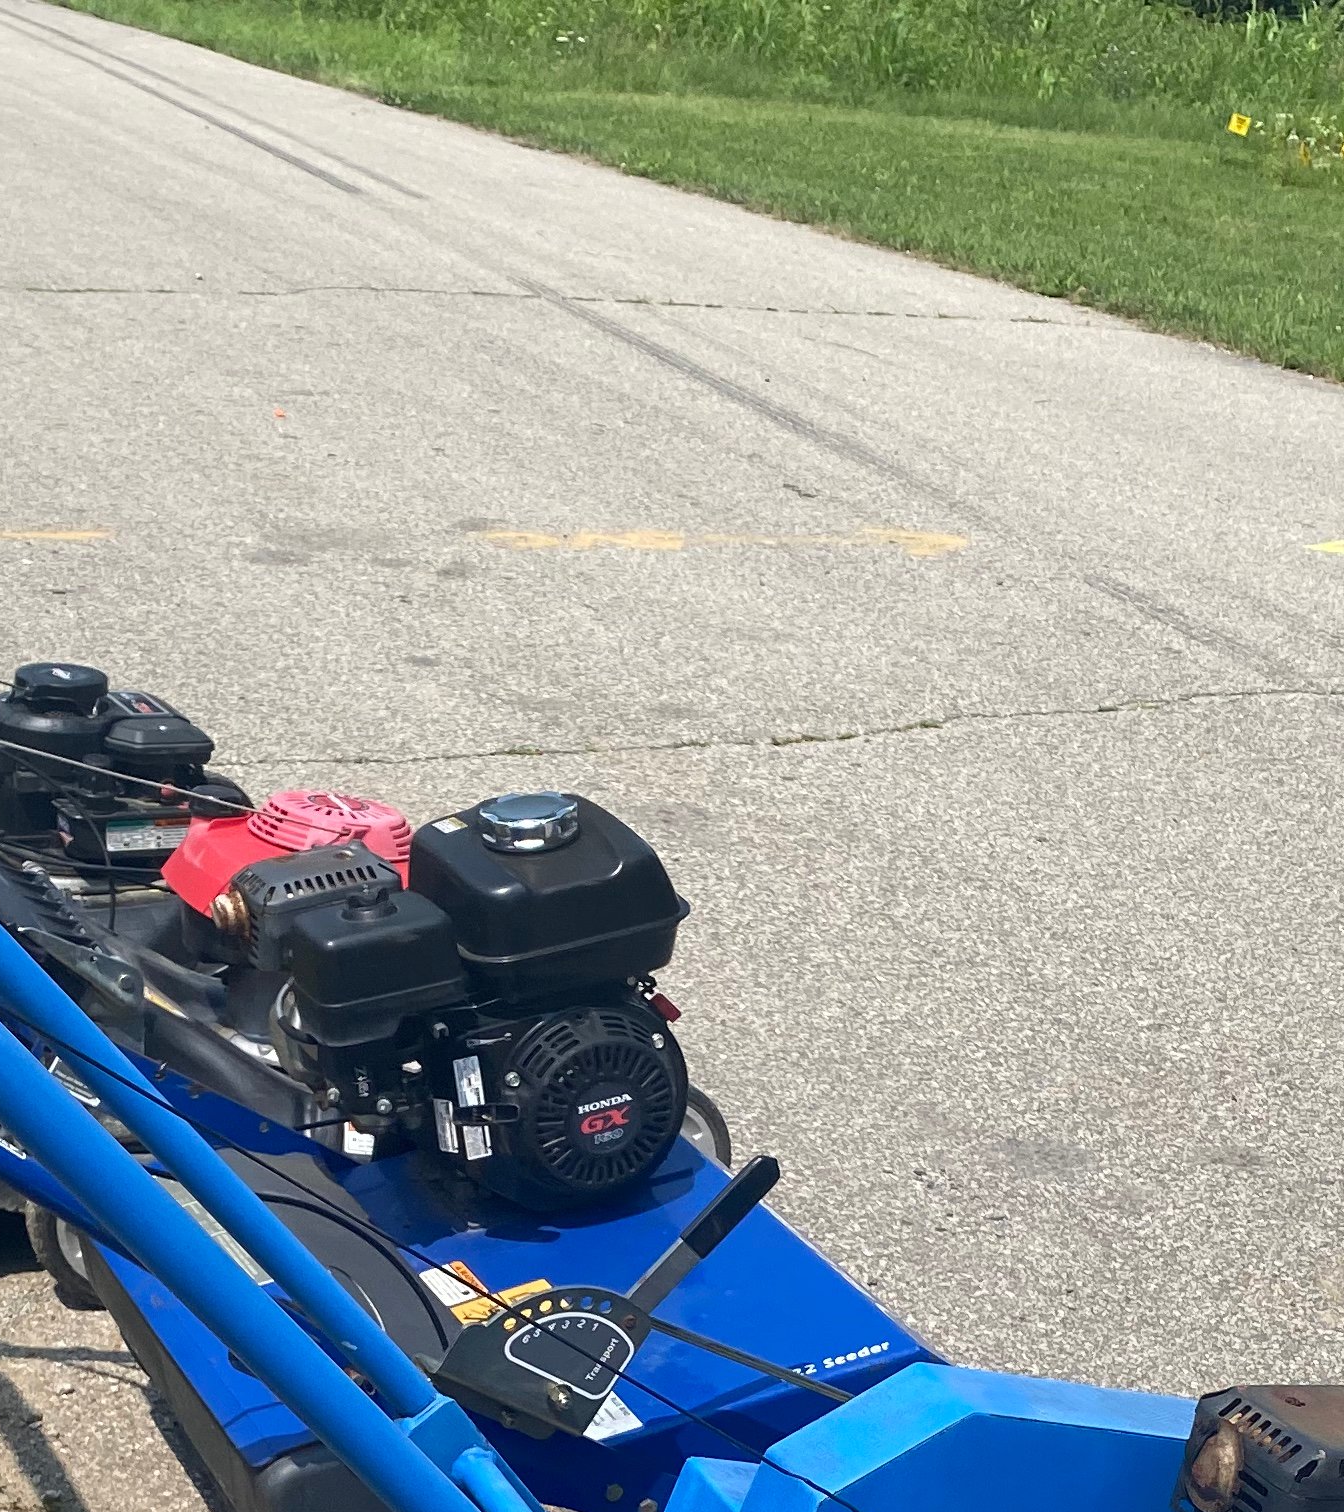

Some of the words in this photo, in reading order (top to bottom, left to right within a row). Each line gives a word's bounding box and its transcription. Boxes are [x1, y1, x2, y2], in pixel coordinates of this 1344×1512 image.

[577, 1093, 634, 1115] HONDA
[580, 1105, 631, 1134] GX
[521, 1334, 531, 1344] 6
[561, 1319, 571, 1330] 3
[576, 1319, 587, 1329] 2
[591, 1322, 599, 1332] 1
[822, 1341, 890, 1369] Seeder
